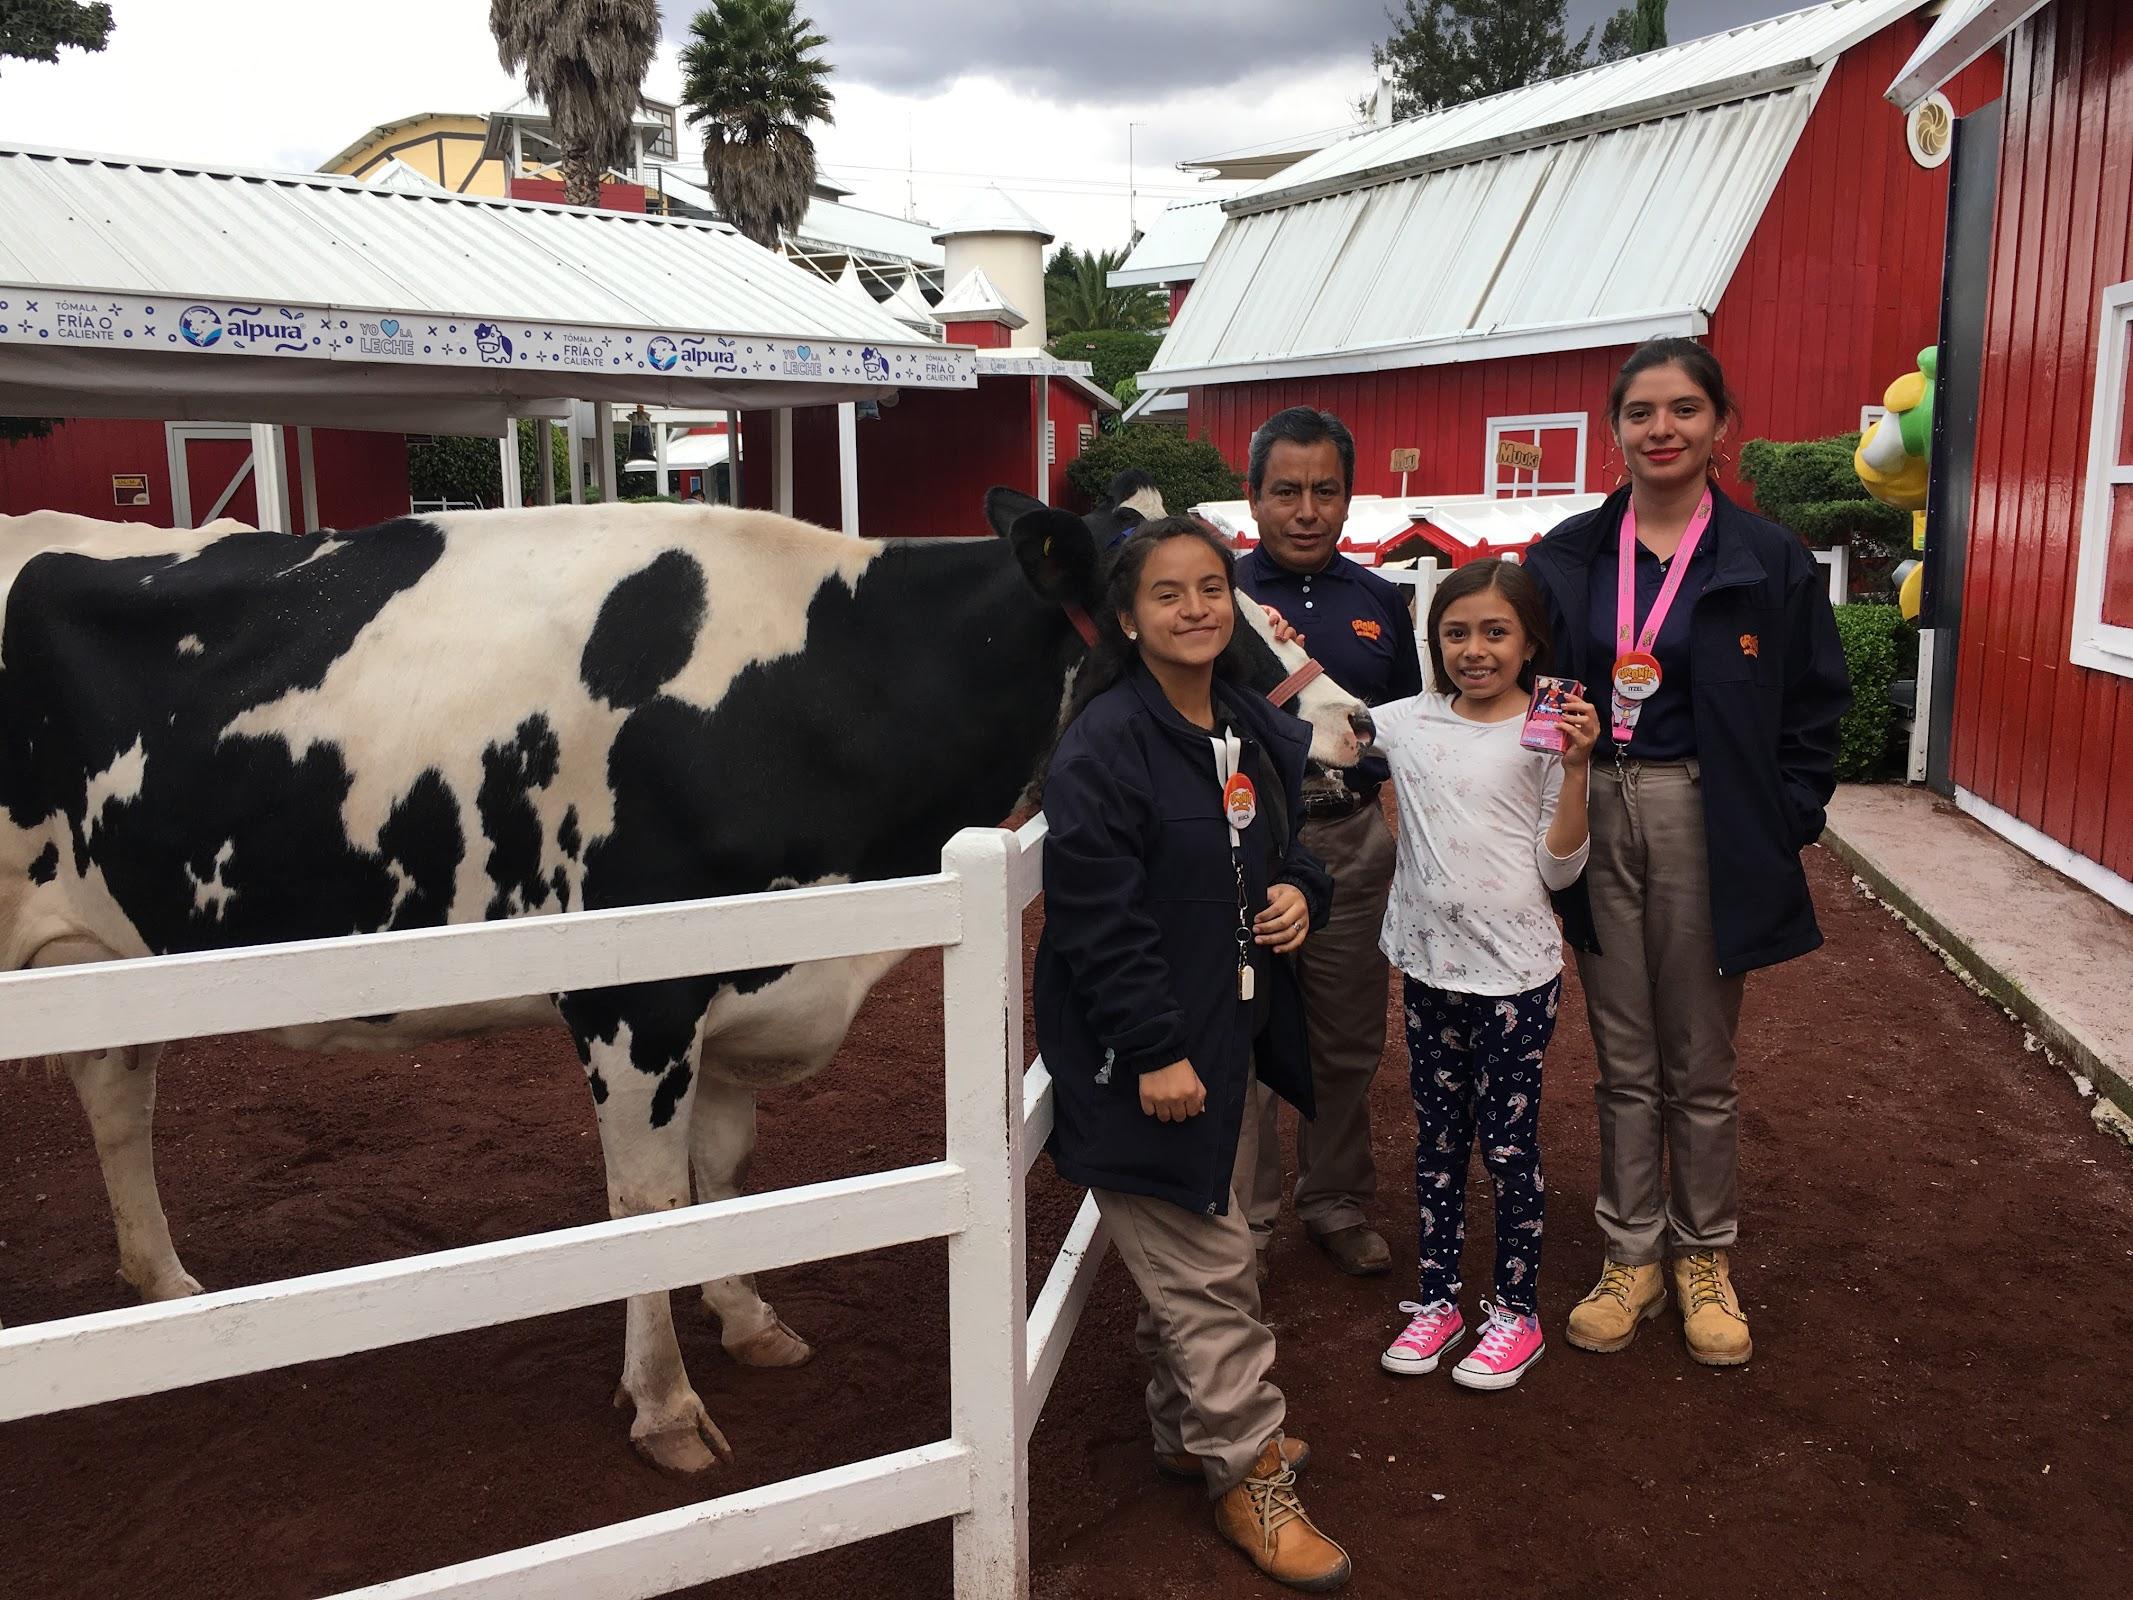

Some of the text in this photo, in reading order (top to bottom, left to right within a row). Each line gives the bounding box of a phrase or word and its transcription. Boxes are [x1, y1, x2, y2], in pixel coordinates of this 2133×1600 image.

[55, 299, 98, 313] TÓMALA
[57, 311, 112, 330] FRÍA O
[58, 328, 115, 341] CALIENTE
[227, 319, 303, 342] alpura
[359, 323, 413, 338] YO LA
[563, 332, 593, 343] TÓMALA
[360, 337, 415, 356] LECHE
[564, 343, 603, 358] FRÍA O
[681, 347, 735, 366] alpura
[782, 348, 797, 360] YO
[925, 353, 948, 362] TÓMALA
[564, 356, 605, 367] CALIENTE
[925, 362, 956, 374] FRÍA O
[783, 361, 823, 377] LECHE
[926, 373, 957, 382] CALIENTE
